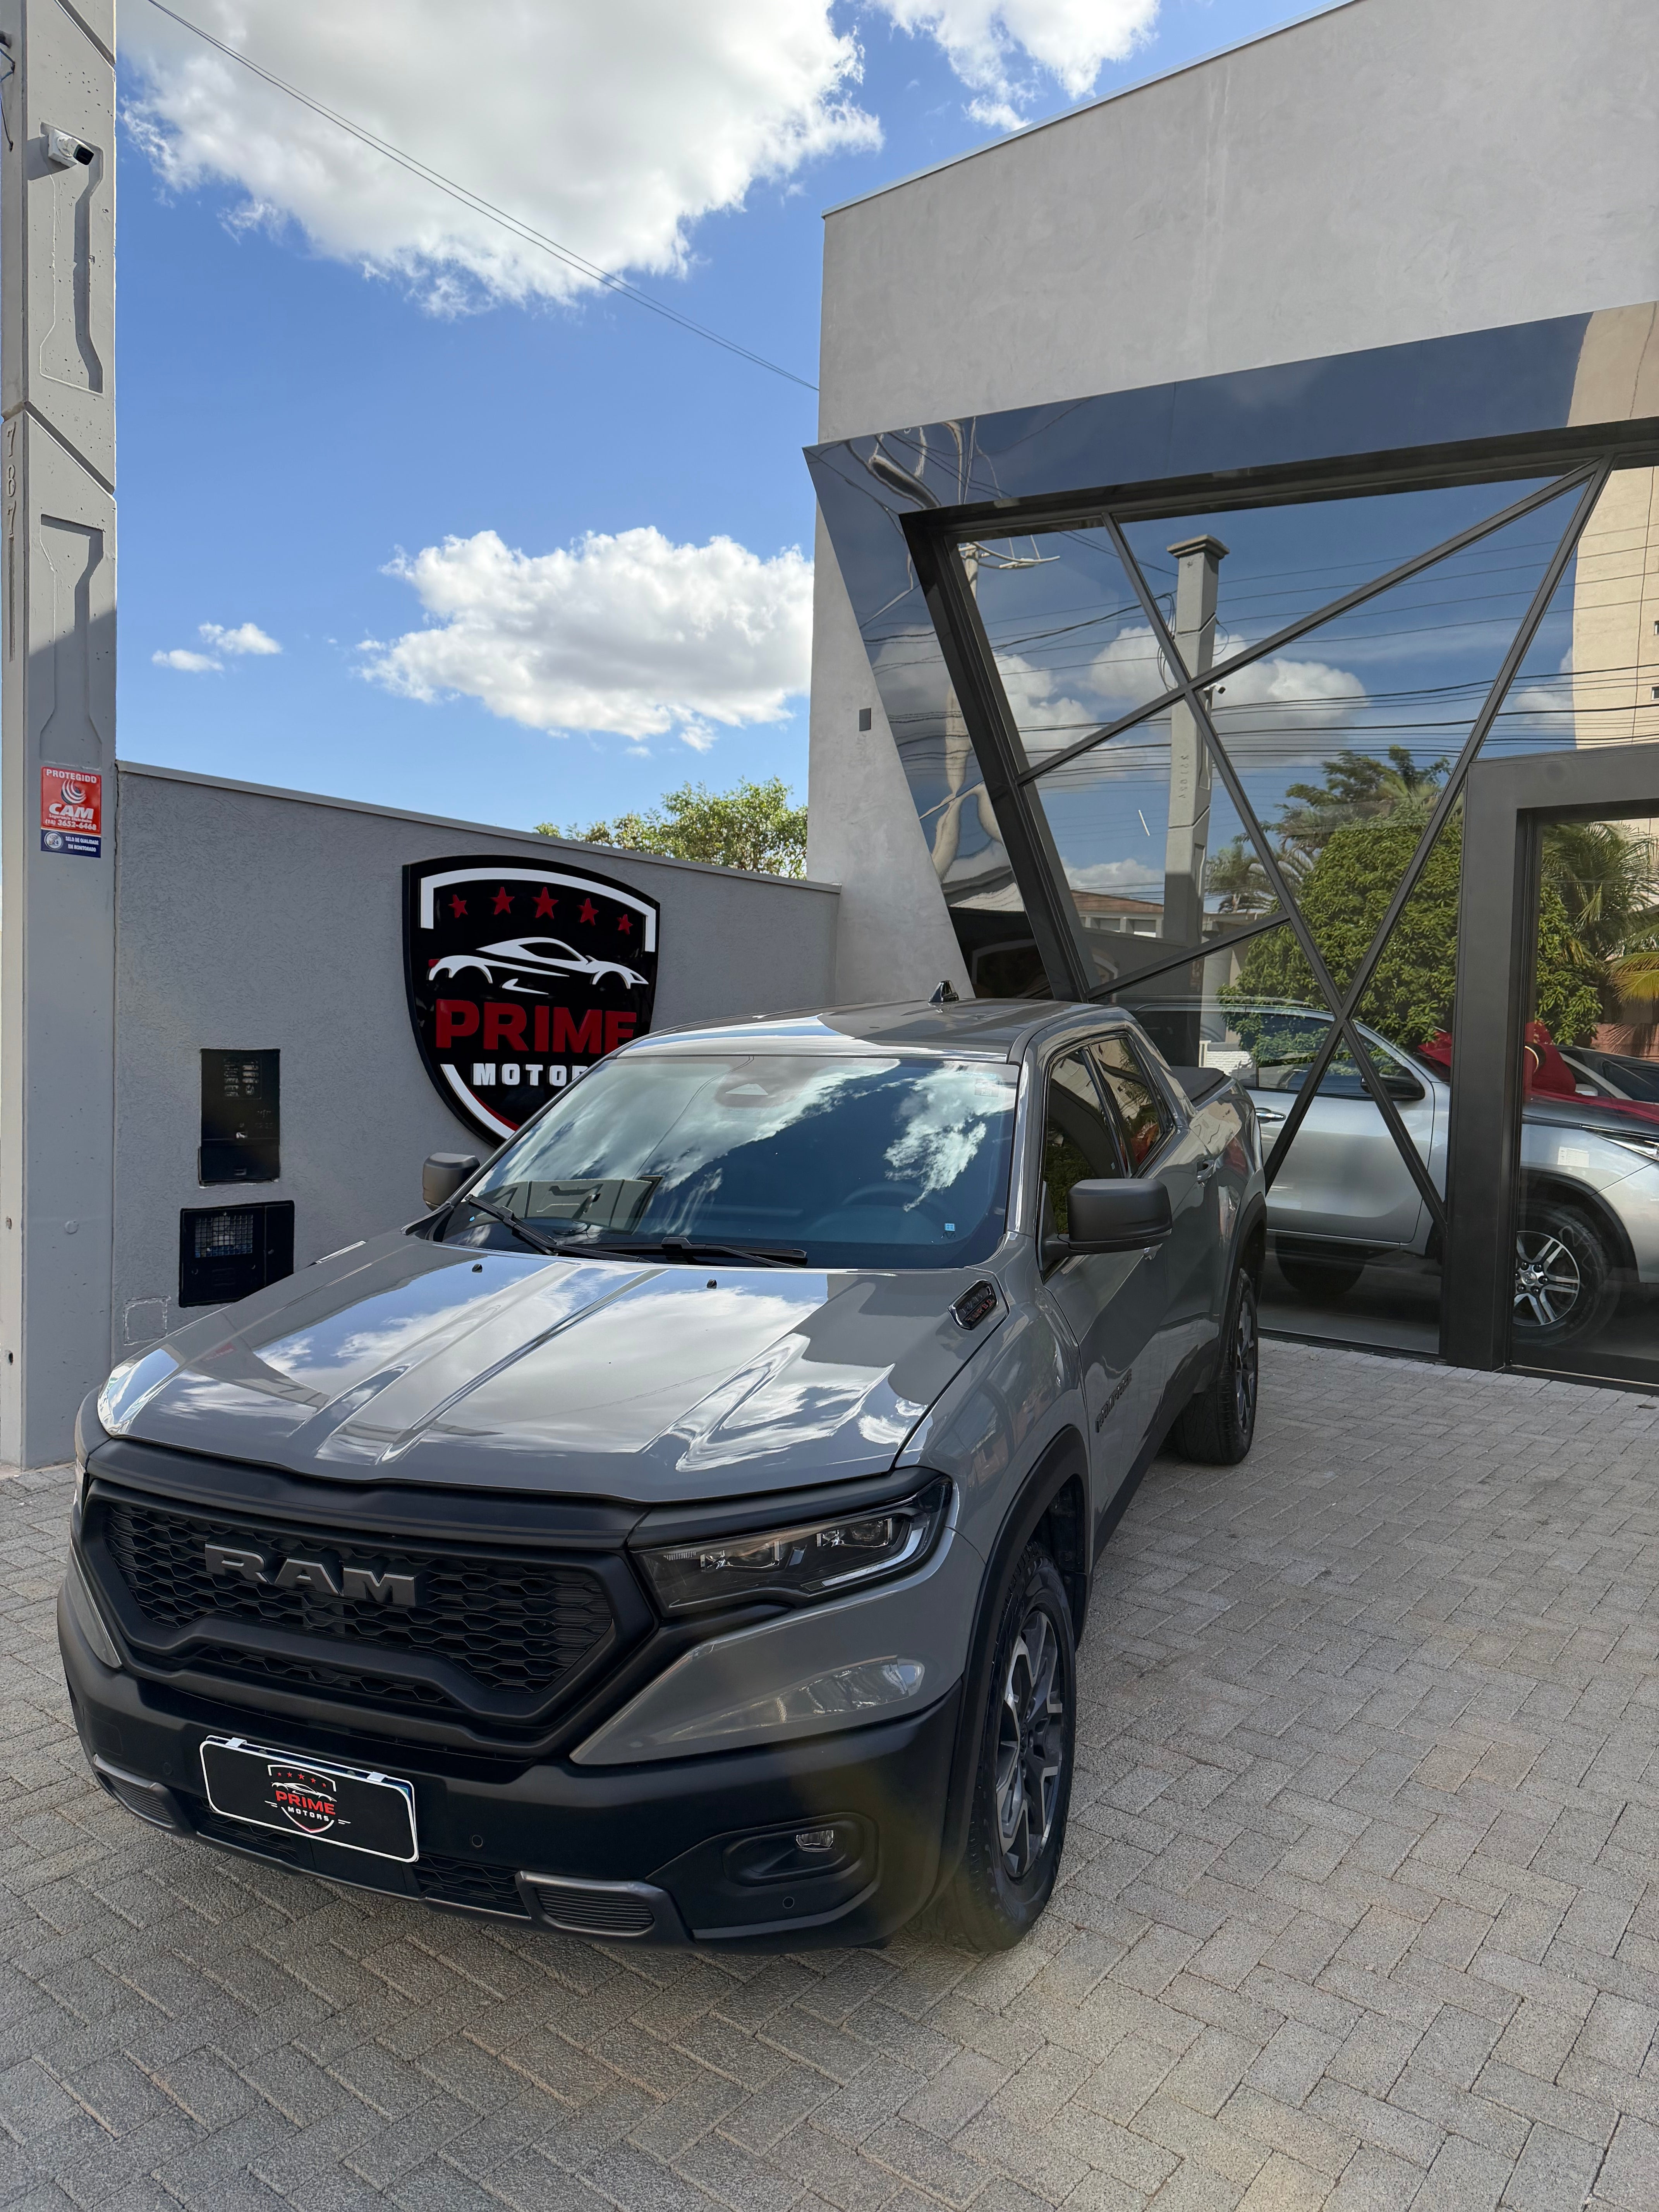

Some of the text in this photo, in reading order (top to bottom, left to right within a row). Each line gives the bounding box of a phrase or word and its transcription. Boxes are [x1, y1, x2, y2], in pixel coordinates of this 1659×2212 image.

[46, 769, 97, 783] PROTEGIDO
[49, 803, 94, 820] CAM
[436, 999, 636, 1054] PRIME
[205, 1543, 416, 1607] RAM
[275, 1790, 336, 1815] PRIME
[287, 1806, 329, 1822] MOTORS
